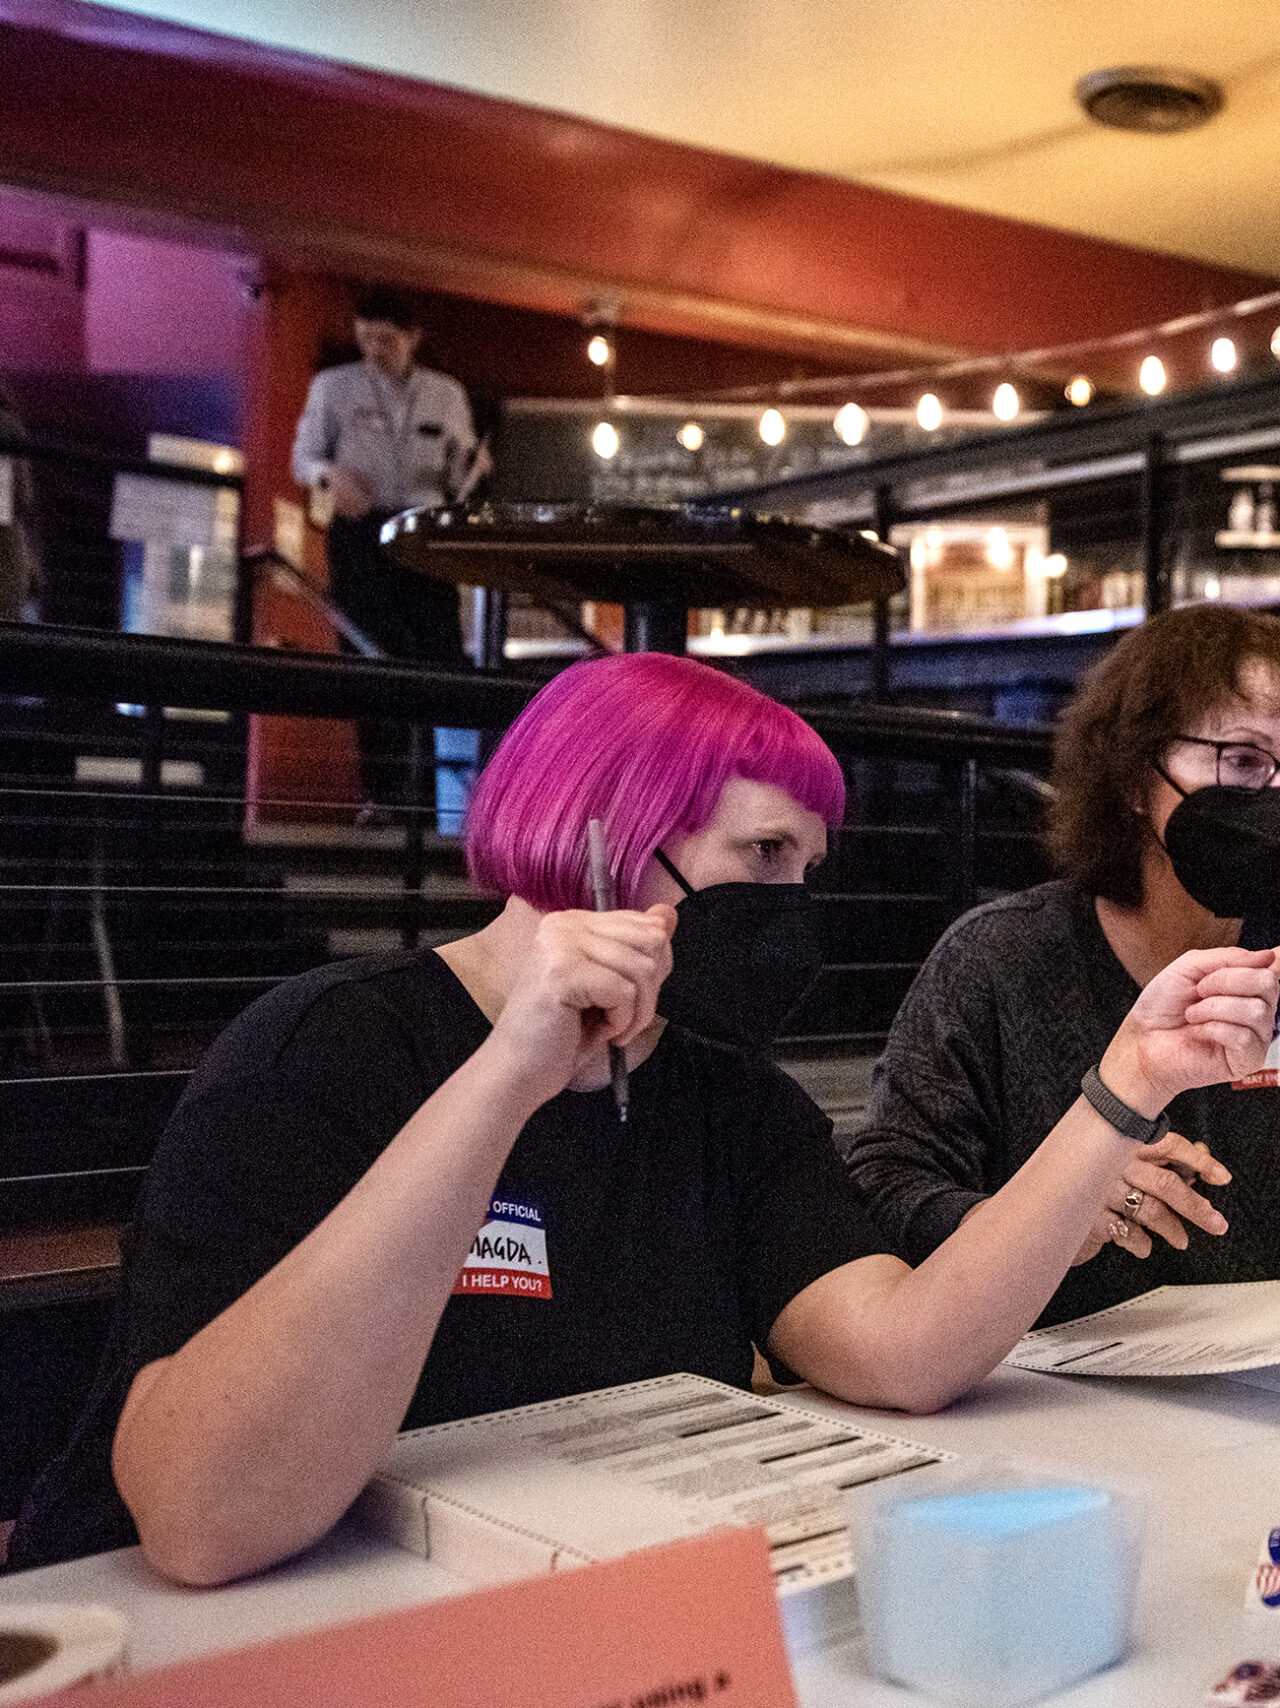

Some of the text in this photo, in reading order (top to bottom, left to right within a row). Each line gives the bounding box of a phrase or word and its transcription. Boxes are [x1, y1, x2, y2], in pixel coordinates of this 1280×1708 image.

[492, 1200, 542, 1222] OFFICIAL
[462, 1274, 543, 1292] I HELP YOU?
